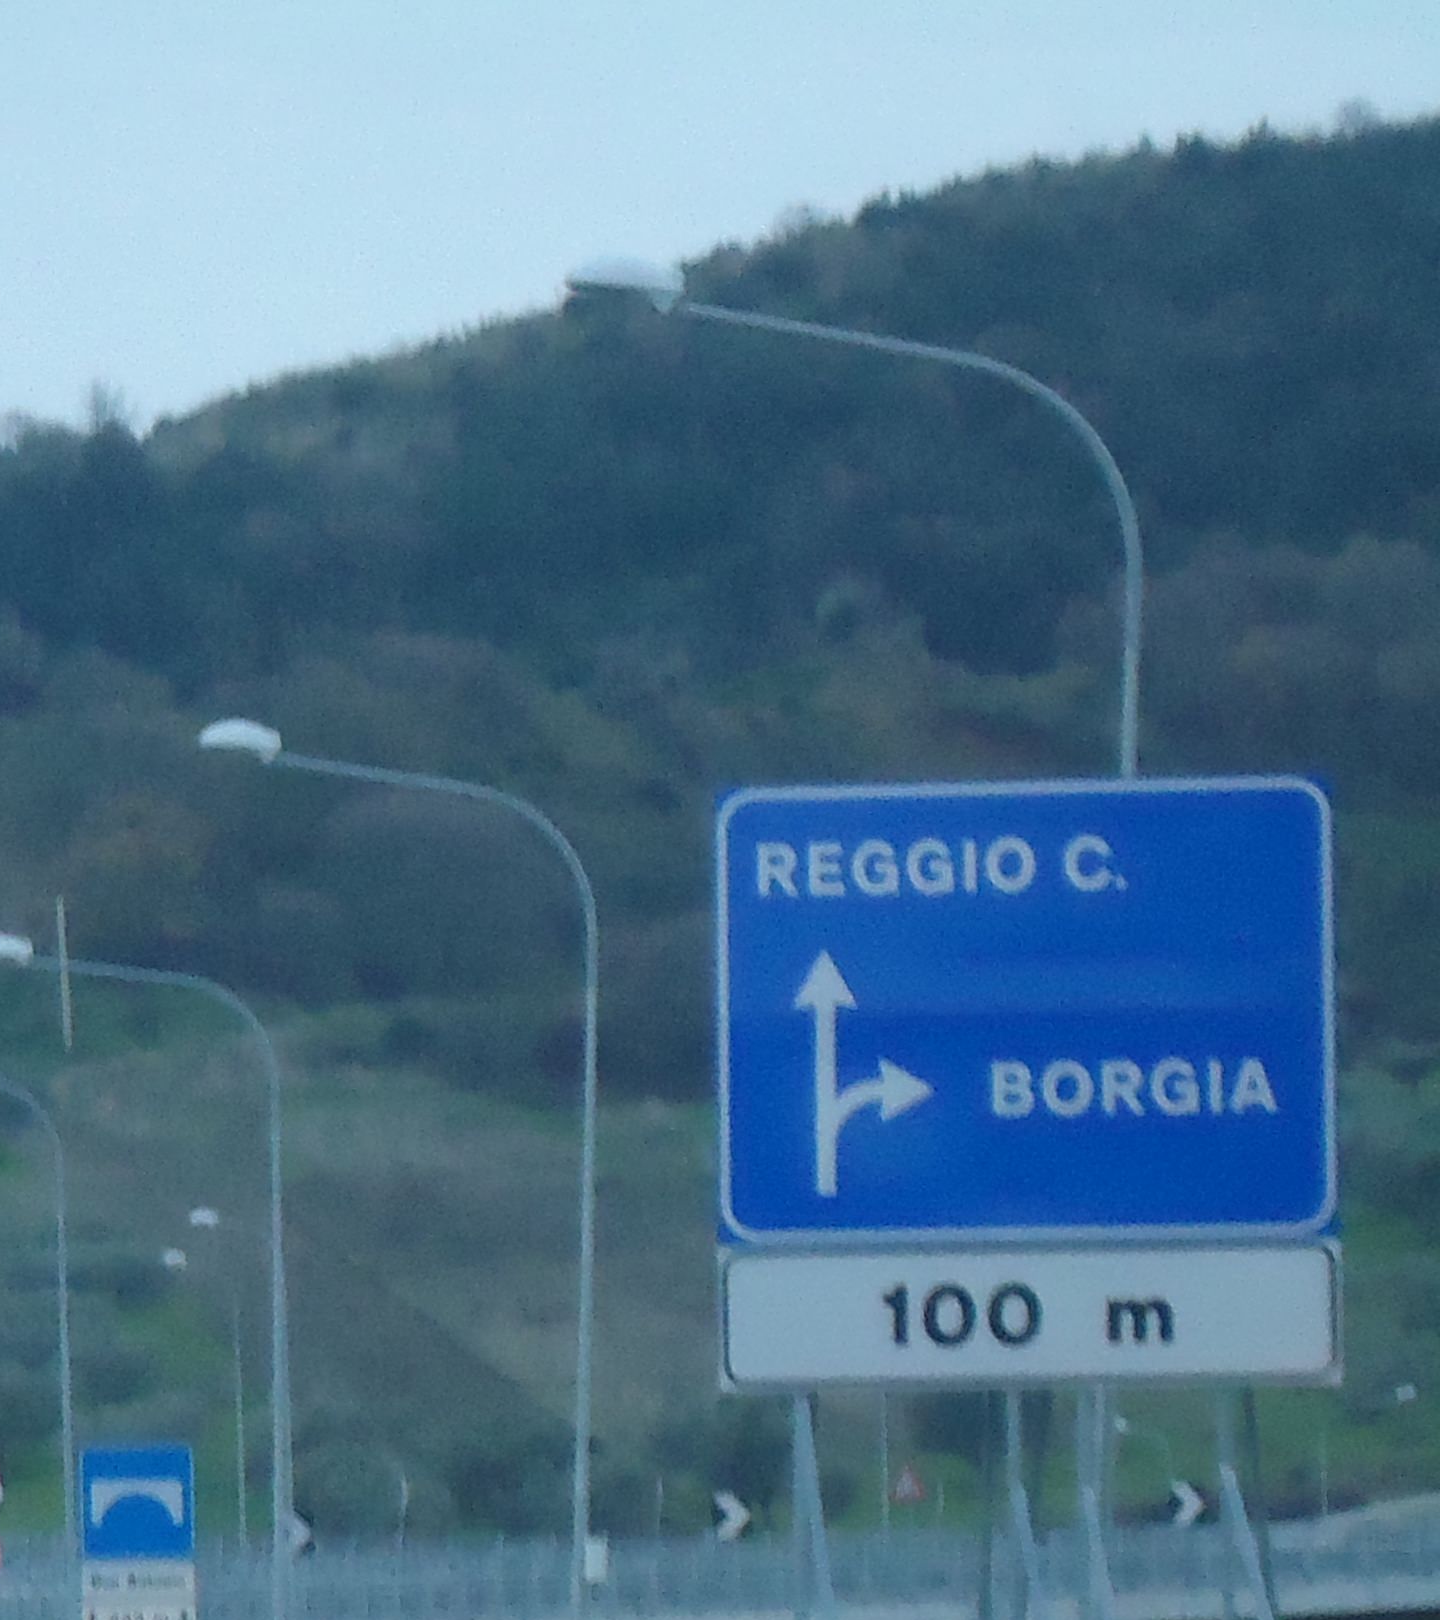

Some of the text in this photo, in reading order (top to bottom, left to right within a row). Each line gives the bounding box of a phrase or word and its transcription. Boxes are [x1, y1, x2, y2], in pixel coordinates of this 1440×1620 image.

[756, 834, 1128, 897] REGGIO C.
[990, 1056, 1278, 1118] BORGIA
[882, 1281, 1176, 1348] 100 m
